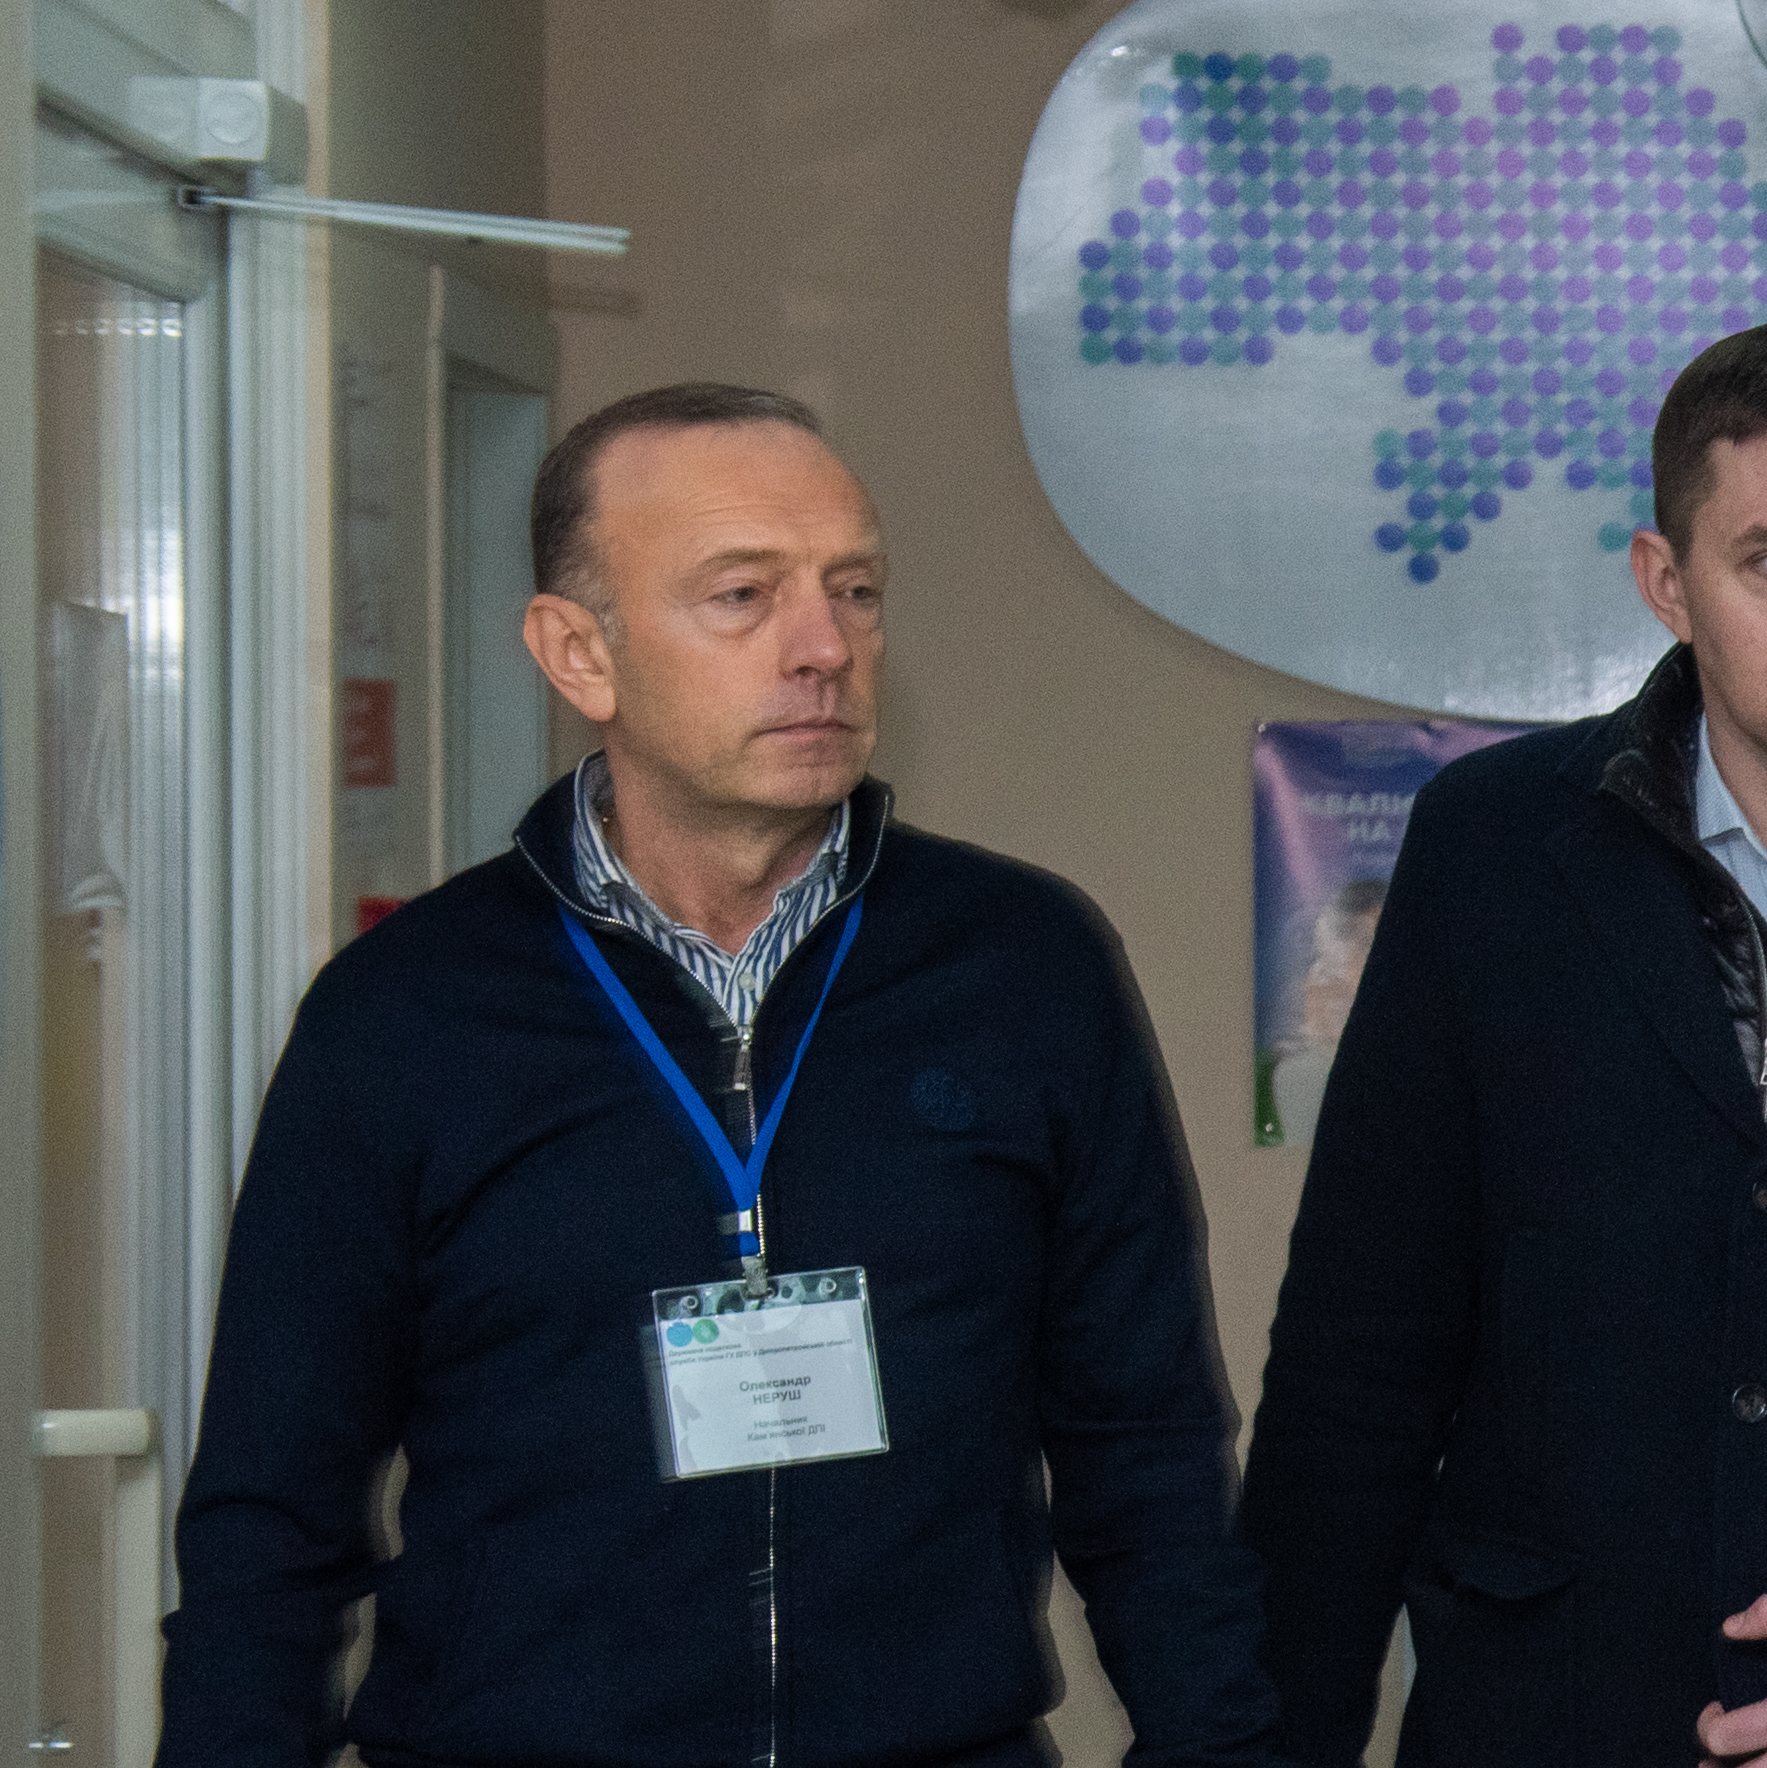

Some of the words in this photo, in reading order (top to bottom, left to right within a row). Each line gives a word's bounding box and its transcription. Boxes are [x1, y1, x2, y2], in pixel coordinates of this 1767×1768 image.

[739, 1375, 811, 1392] Олександр
[752, 1389, 802, 1405] НЕРУШ
[753, 1416, 808, 1429] Начальник
[808, 1424, 826, 1436] ДПІ
